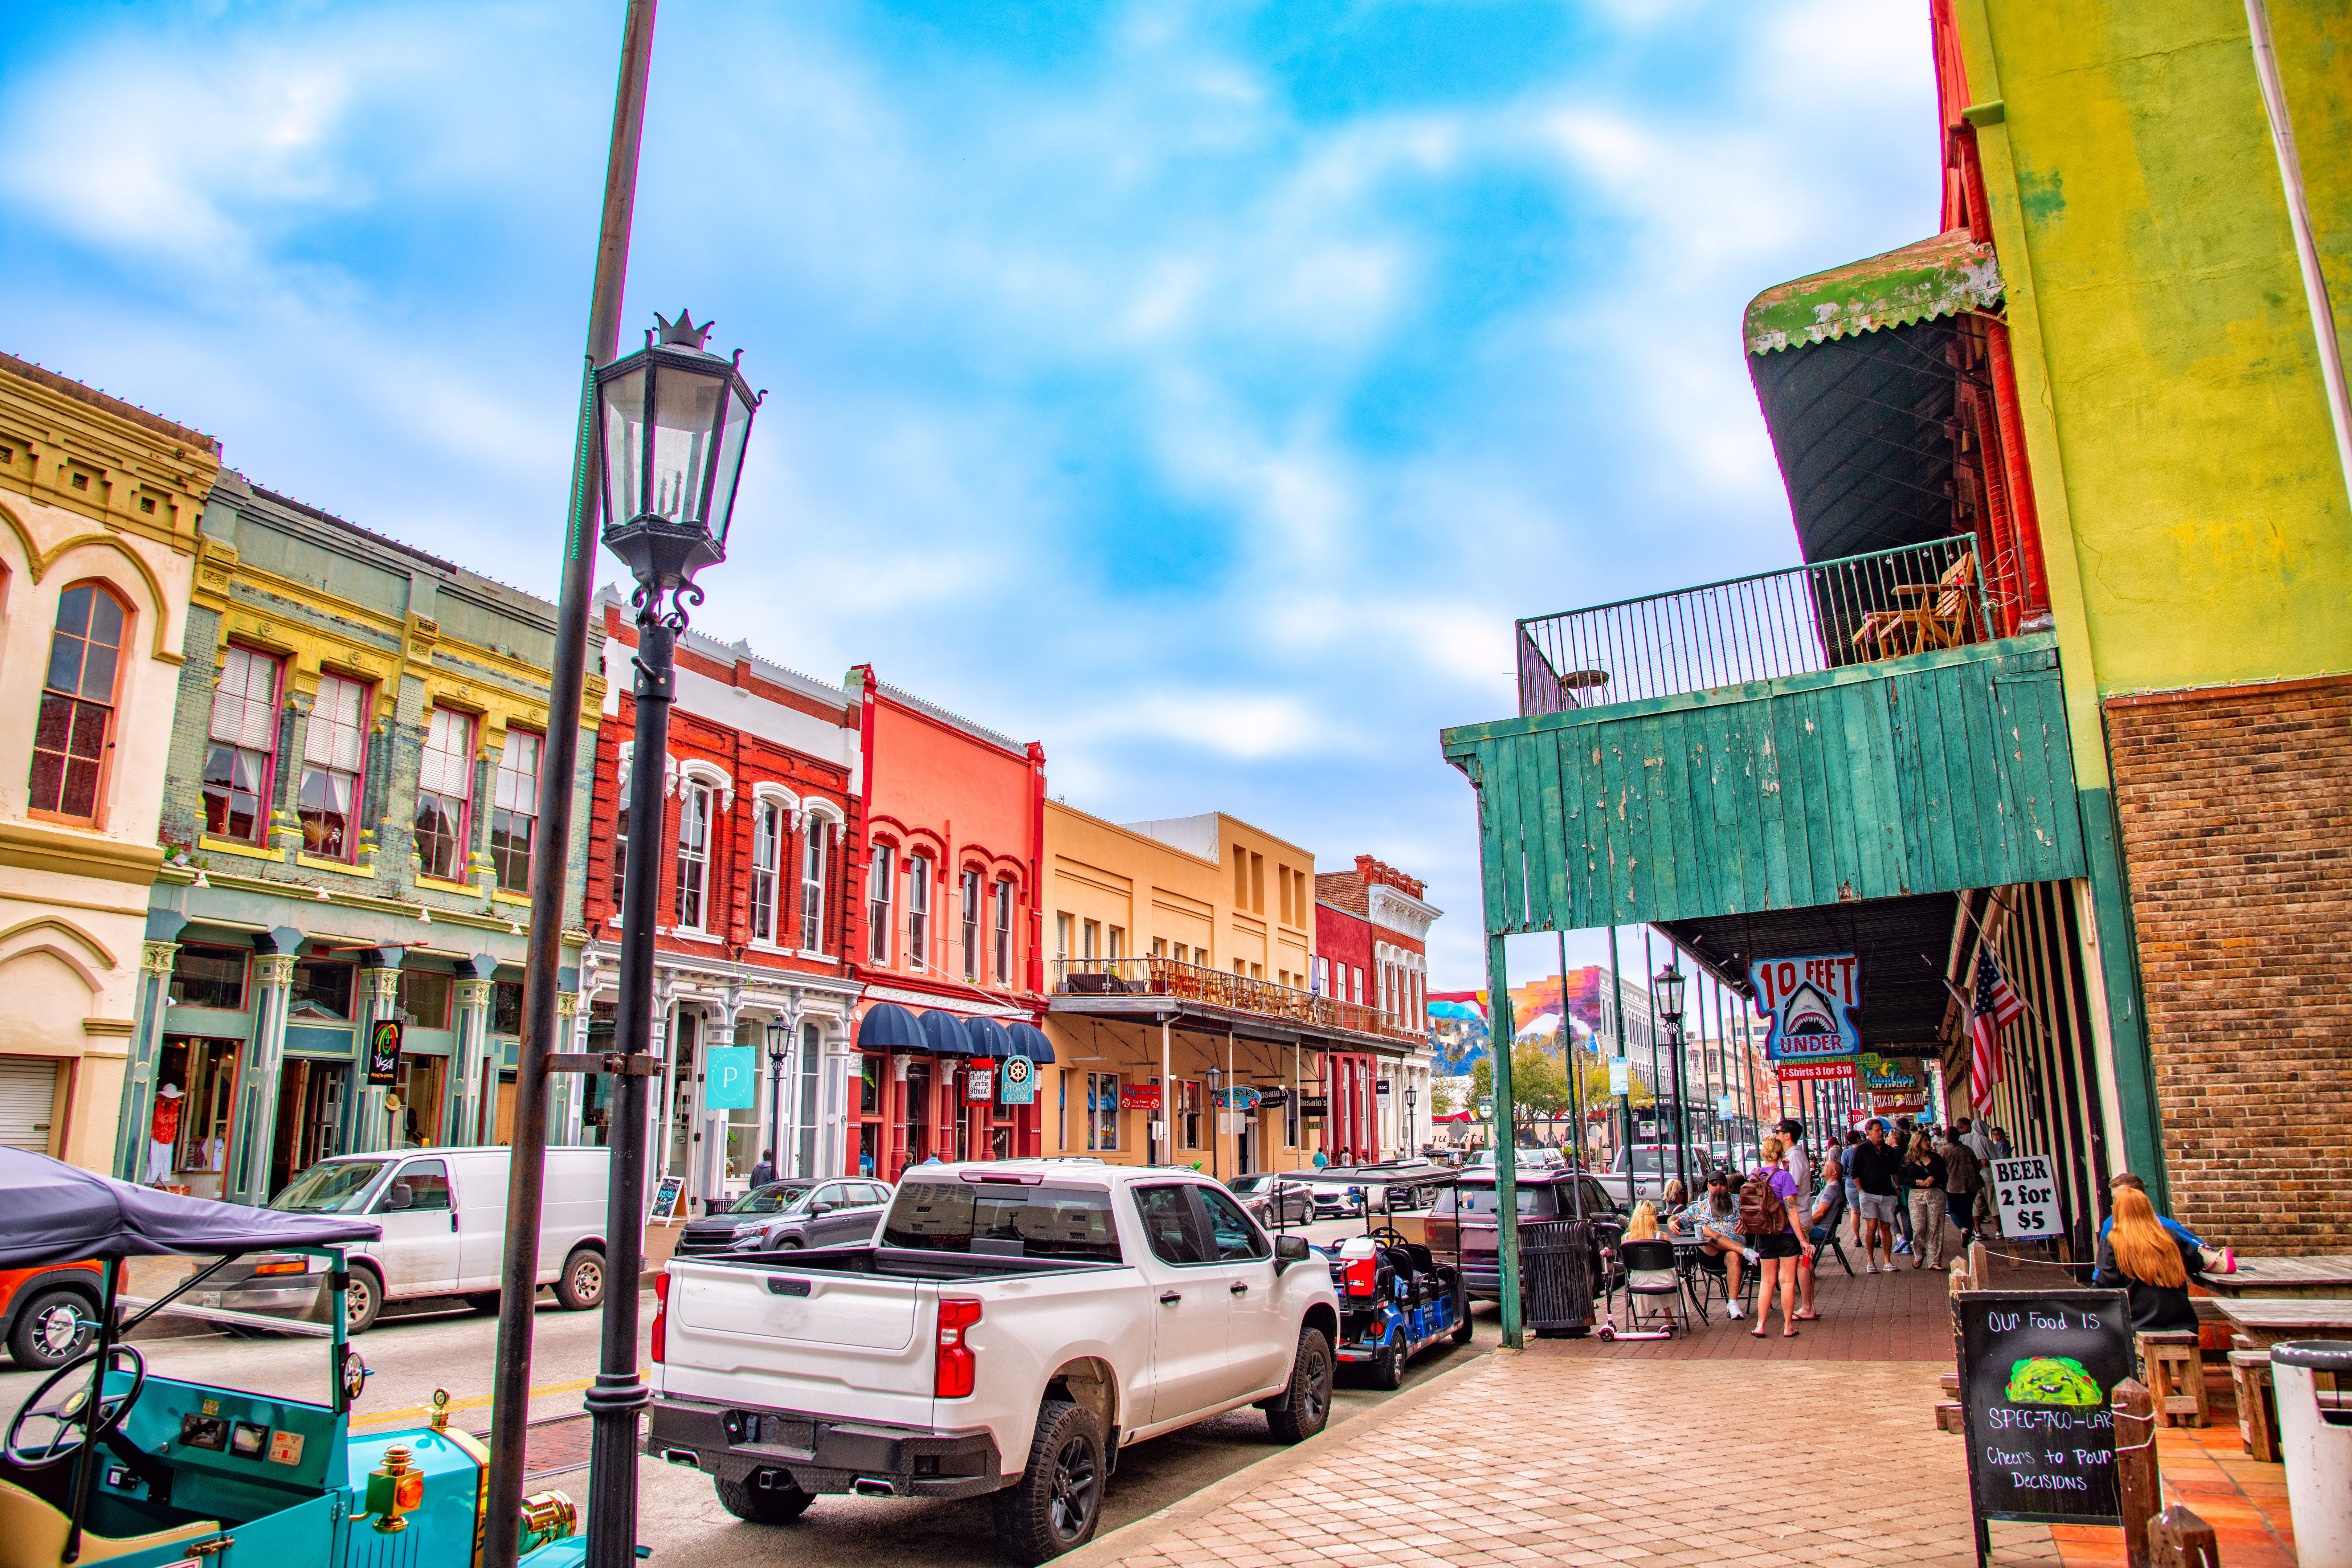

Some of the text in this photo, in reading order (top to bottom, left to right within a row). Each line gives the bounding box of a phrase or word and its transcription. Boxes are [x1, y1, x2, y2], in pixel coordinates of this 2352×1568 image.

[1760, 957, 1855, 1010] 10 FEET
[1780, 1034, 1843, 1053] UNDER
[1786, 1054, 1876, 1065] CONVERSATION PIECES
[724, 1067, 738, 1088] P
[969, 1072, 991, 1080] Christmas
[1781, 1065, 1852, 1077] T-Shirts 3 for $10
[969, 1085, 989, 1094] Strand
[1004, 1082, 1032, 1093] STRAND
[1123, 1086, 1136, 1098] Play
[1006, 1093, 1029, 1102] BRASS
[1873, 1093, 1924, 1107] PELICAN ISLAND
[1995, 1159, 2048, 1182] BEER
[664, 1183, 675, 1191] Happy
[659, 1190, 677, 1199] BIRTHDAY
[2000, 1184, 2051, 1206] 2 for
[2017, 1209, 2045, 1230] $5
[2029, 1312, 2068, 1330] Food
[2082, 1313, 2100, 1329] IS
[1986, 1446, 2112, 1466] Cheers to Pour
